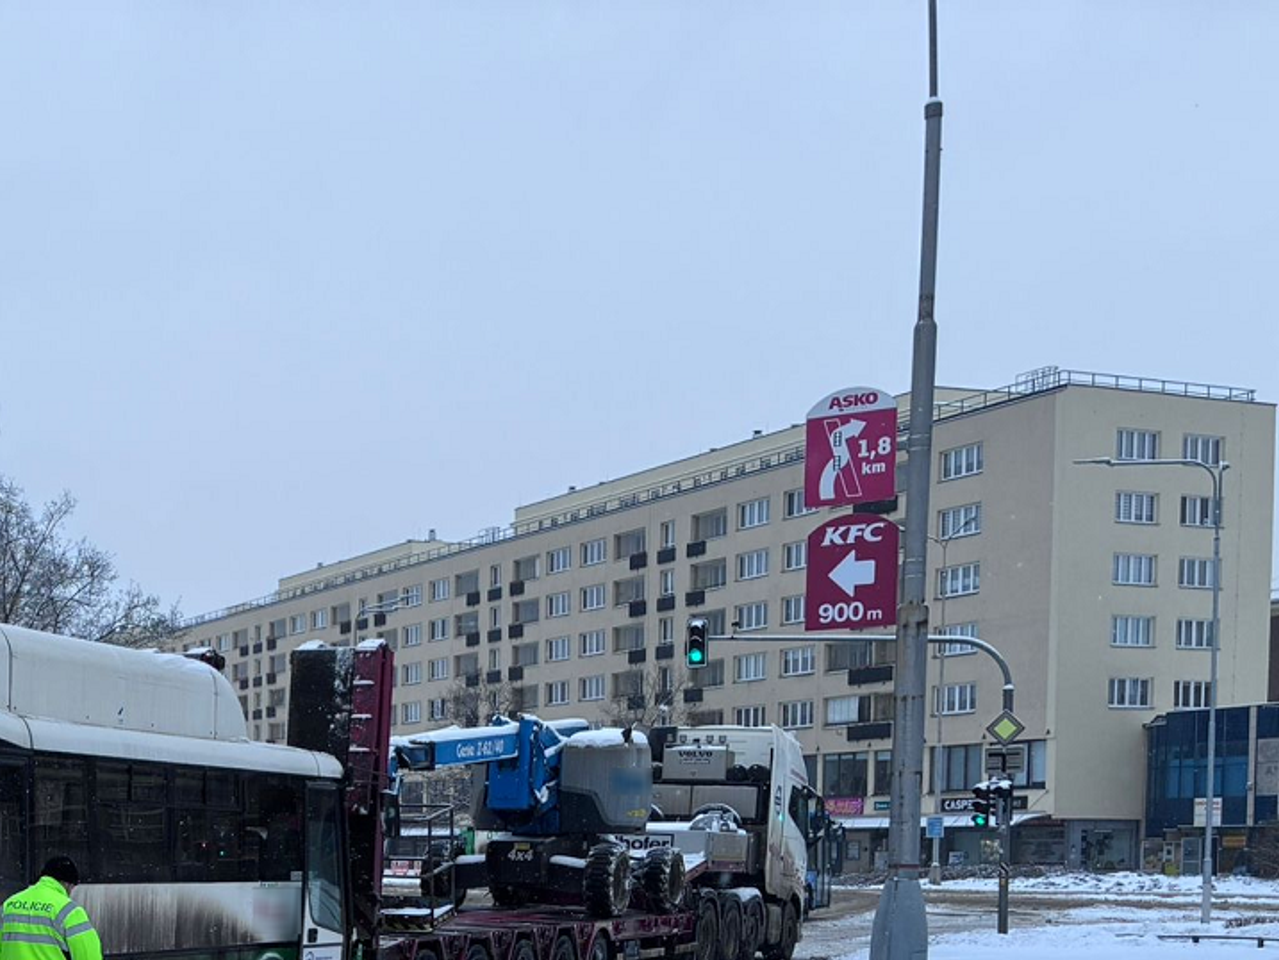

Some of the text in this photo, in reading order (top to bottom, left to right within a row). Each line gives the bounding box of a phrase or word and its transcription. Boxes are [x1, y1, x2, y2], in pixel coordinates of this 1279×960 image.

[829, 392, 878, 410] ASKO
[858, 436, 891, 459] 1,8
[862, 462, 886, 475] km
[820, 522, 886, 546] KFC
[819, 602, 882, 623] 900 m
[614, 835, 670, 849] hofer
[507, 849, 534, 861] 4x4
[6, 901, 53, 912] POLICIE
